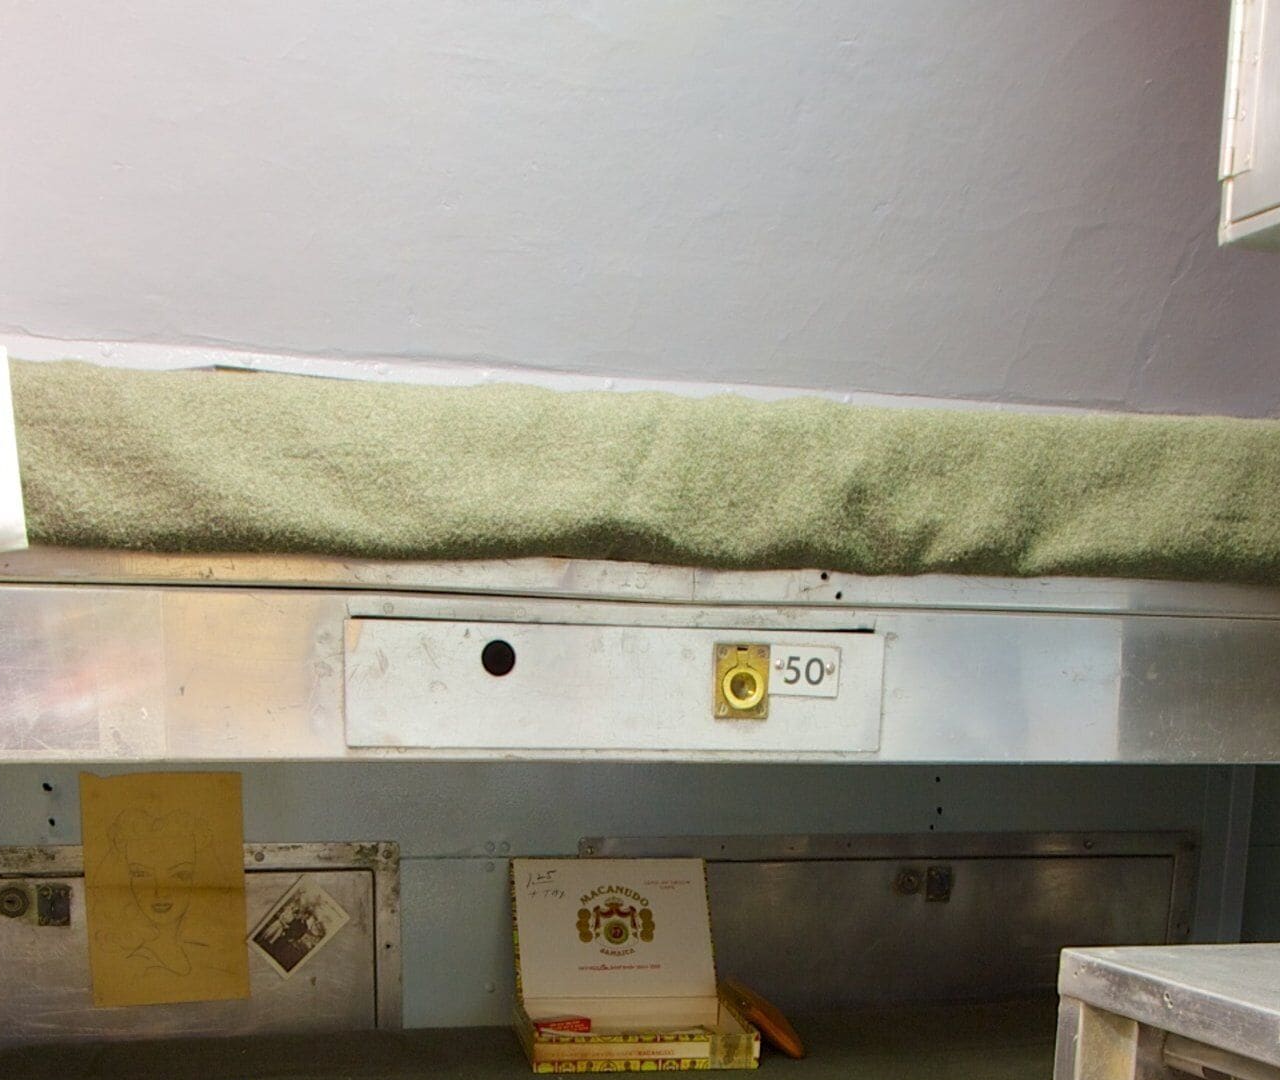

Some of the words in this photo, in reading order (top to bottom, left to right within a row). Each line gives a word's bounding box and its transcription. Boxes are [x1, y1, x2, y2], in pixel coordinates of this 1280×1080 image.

[783, 655, 825, 686] 50
[579, 884, 650, 907] MACANUDO
[599, 947, 637, 957] JAMAICA
